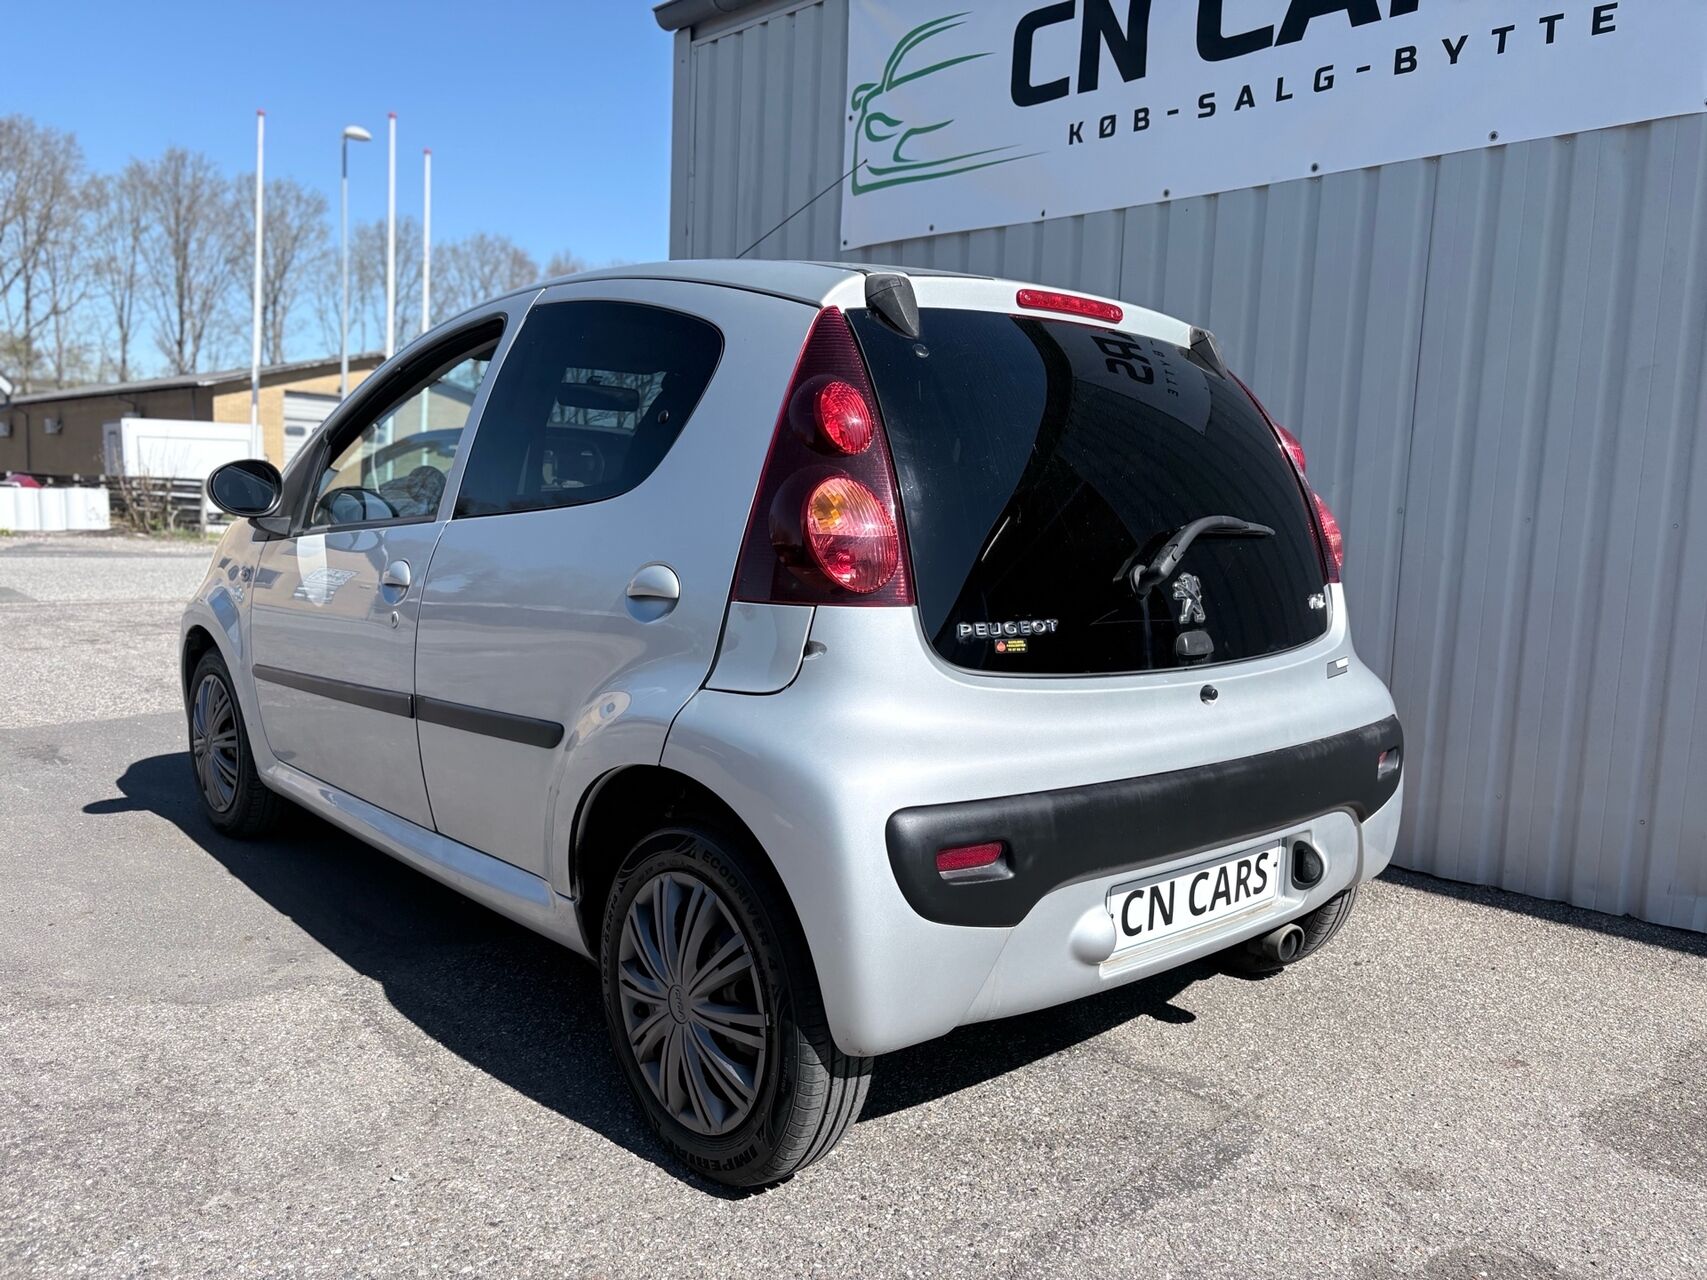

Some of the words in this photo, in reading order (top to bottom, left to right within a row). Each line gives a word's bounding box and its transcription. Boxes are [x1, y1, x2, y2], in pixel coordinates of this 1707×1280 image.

[1011, 0, 1152, 107] CN
[957, 618, 1059, 638] PEUGEOT
[702, 850, 770, 945] ECODRIVER
[1121, 881, 1175, 937] CN
[1189, 852, 1269, 916] CARS
